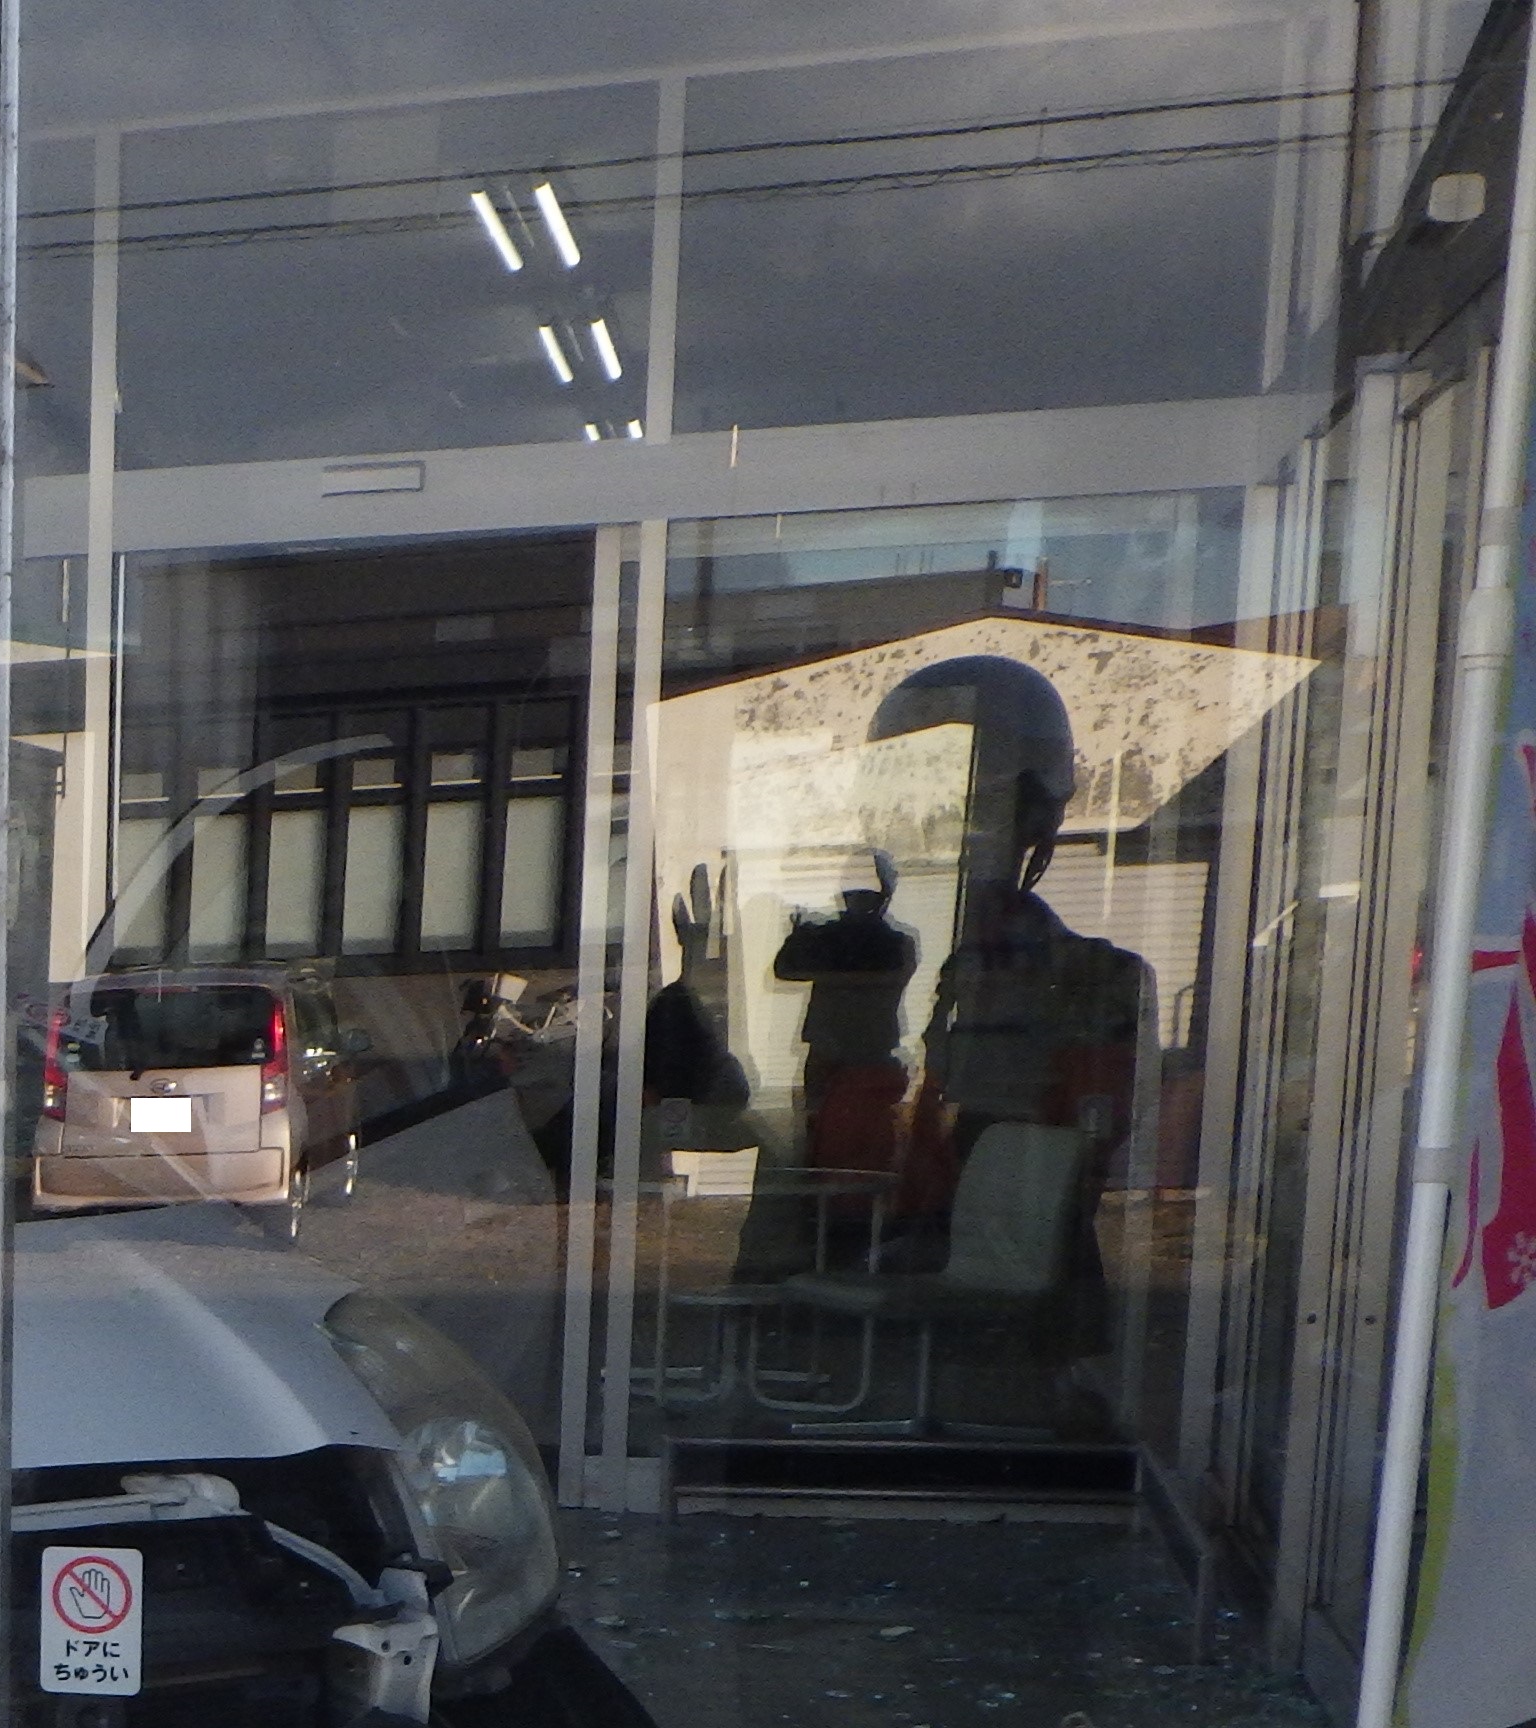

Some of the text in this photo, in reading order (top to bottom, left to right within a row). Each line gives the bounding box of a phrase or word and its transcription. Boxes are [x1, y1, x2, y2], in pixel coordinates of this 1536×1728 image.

[64, 1638, 121, 1660] ドアに
[53, 1661, 130, 1684] ちゅうい
